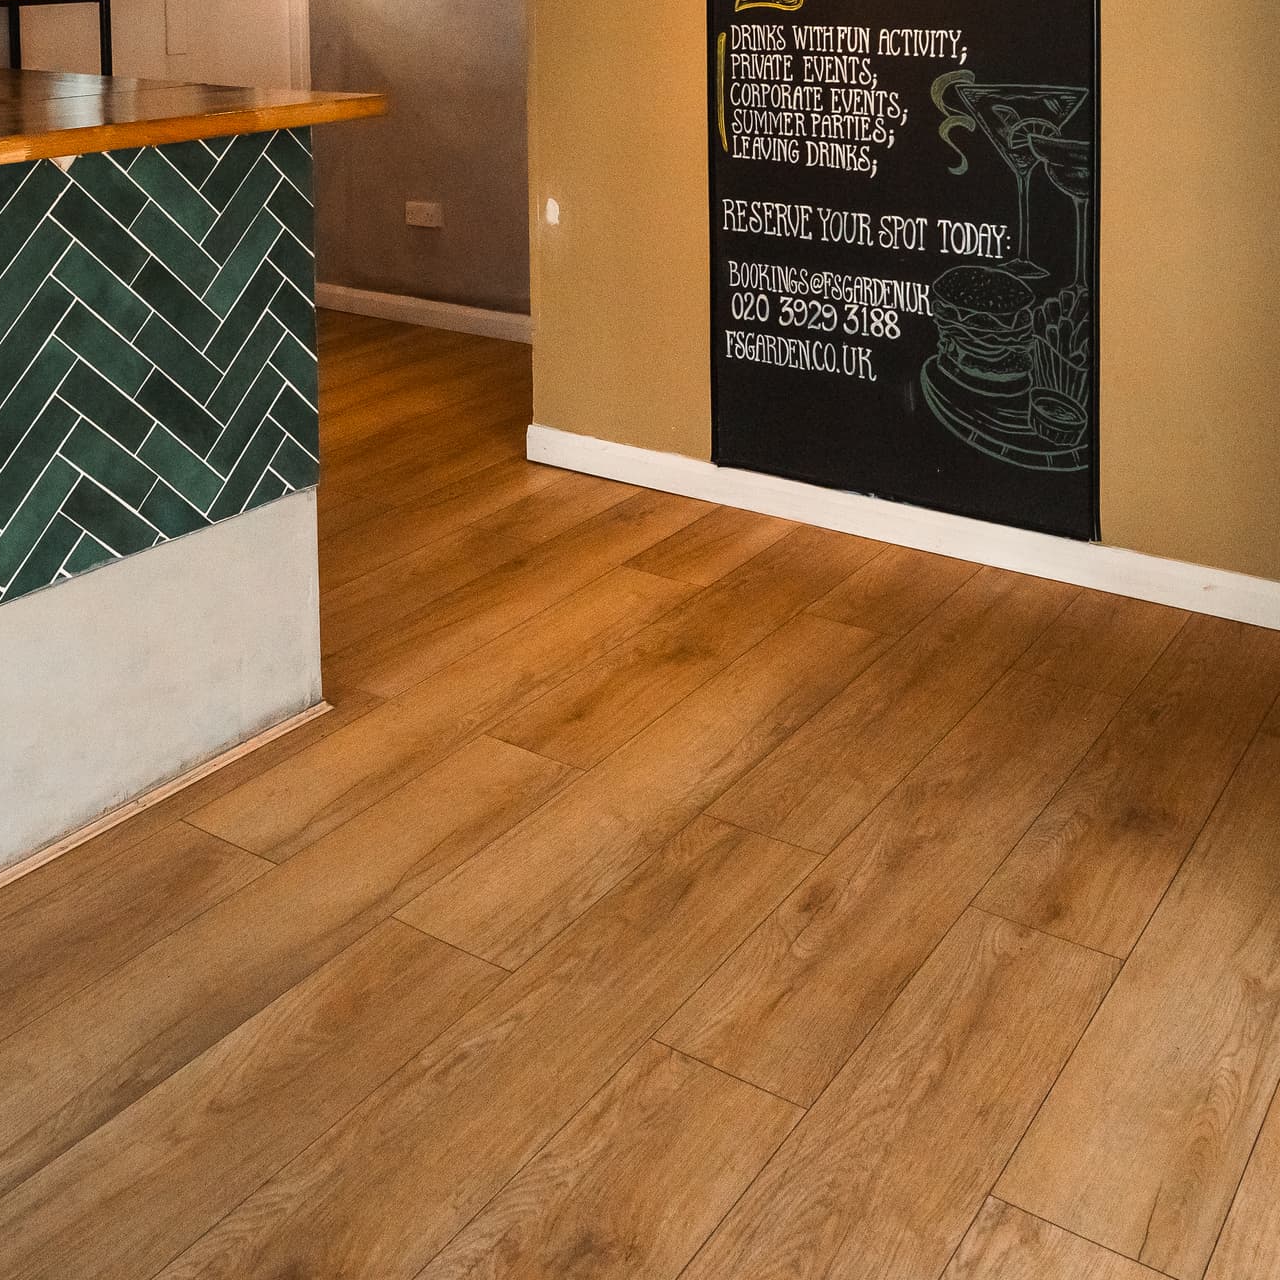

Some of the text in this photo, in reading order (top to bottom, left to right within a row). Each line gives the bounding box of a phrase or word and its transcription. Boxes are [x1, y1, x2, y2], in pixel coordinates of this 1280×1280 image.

[730, 24, 787, 51] DRINKS
[877, 29, 968, 65] ACTIVITY;
[730, 54, 878, 89] PRIVATE EVENTS;
[730, 82, 908, 126] CORPORATE EVENTS;
[731, 109, 895, 148] SUMMER PARTIES;
[732, 135, 878, 178] LEAVING DRINKS;
[722, 199, 1013, 259] RESERVE YOUR SPOT TODAY:
[728, 260, 934, 317] BOOKINGS@FSGARDEN.UK
[731, 291, 902, 339] 020 3929 3188
